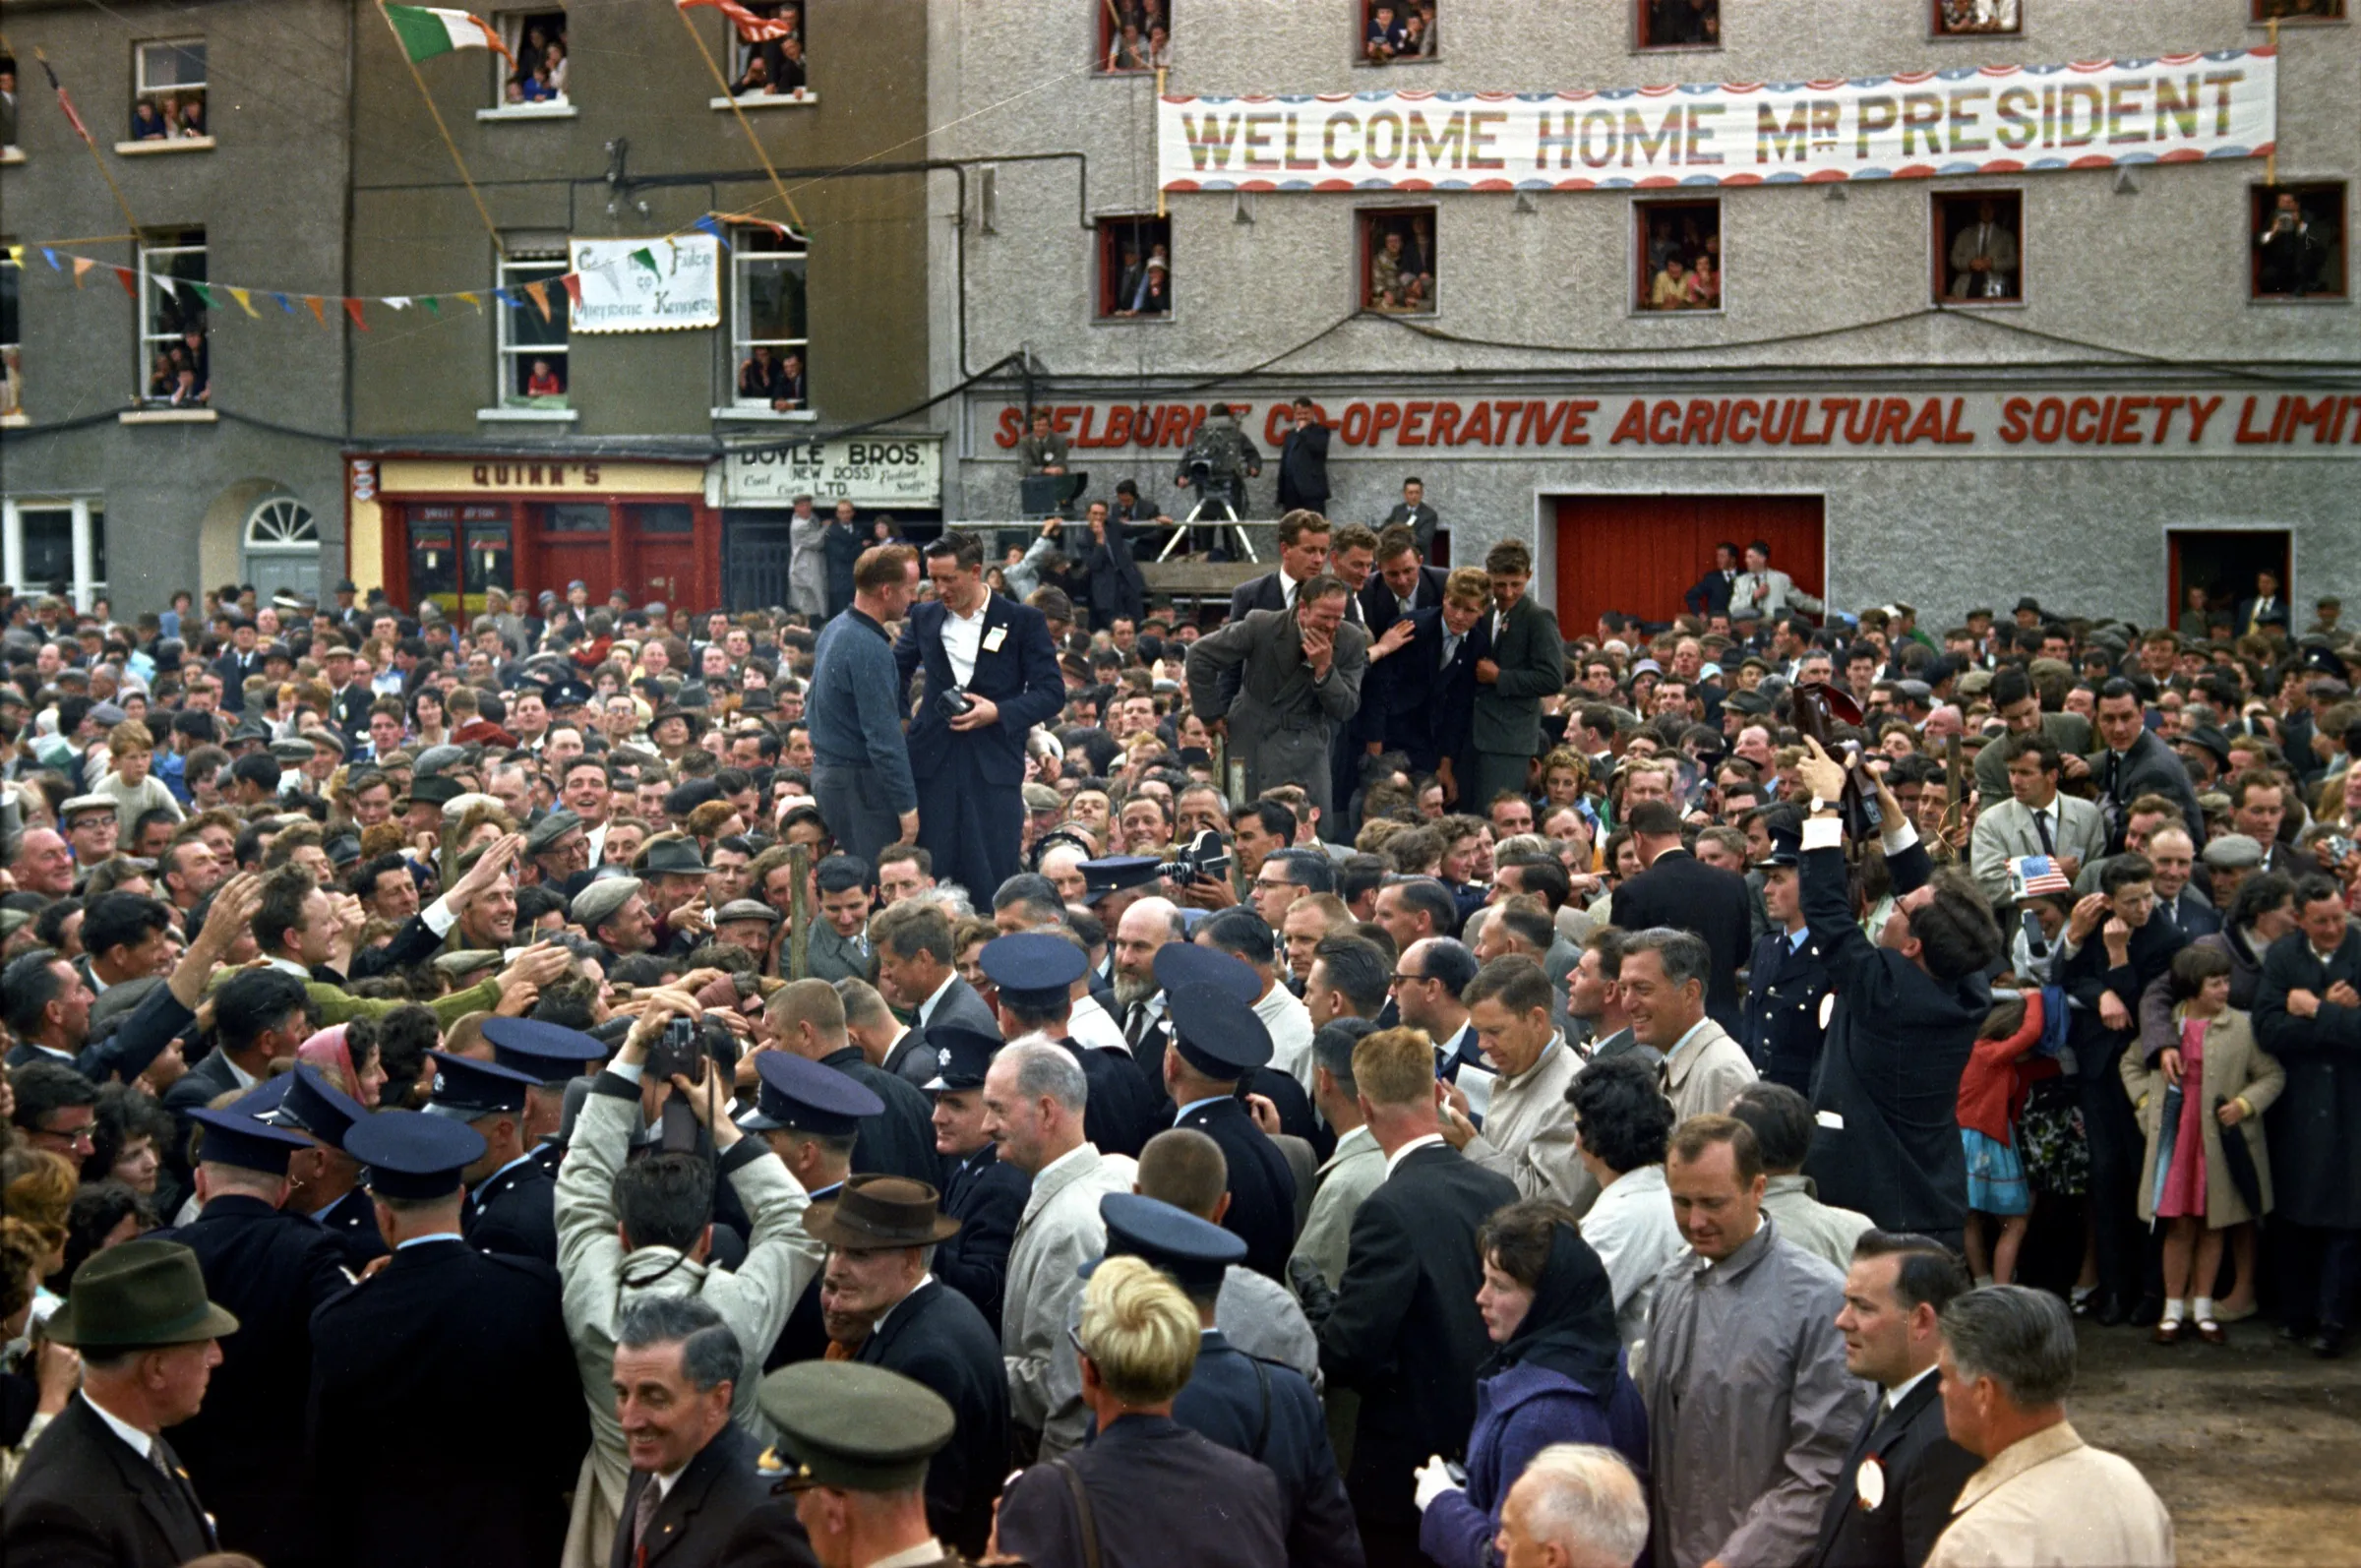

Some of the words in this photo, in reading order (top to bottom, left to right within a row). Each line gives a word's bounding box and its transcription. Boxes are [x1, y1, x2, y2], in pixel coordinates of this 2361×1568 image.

[1181, 110, 1508, 170] WELCOME
[1537, 103, 1725, 169] HOME
[1856, 70, 2246, 158] PRESIDENT
[1609, 396, 1974, 446] AGRICULTURAL
[1999, 395, 2222, 445] SOCIETY
[741, 444, 824, 465] DOYLE
[848, 443, 925, 465] BROS.
[473, 463, 600, 486] QUINN'S
